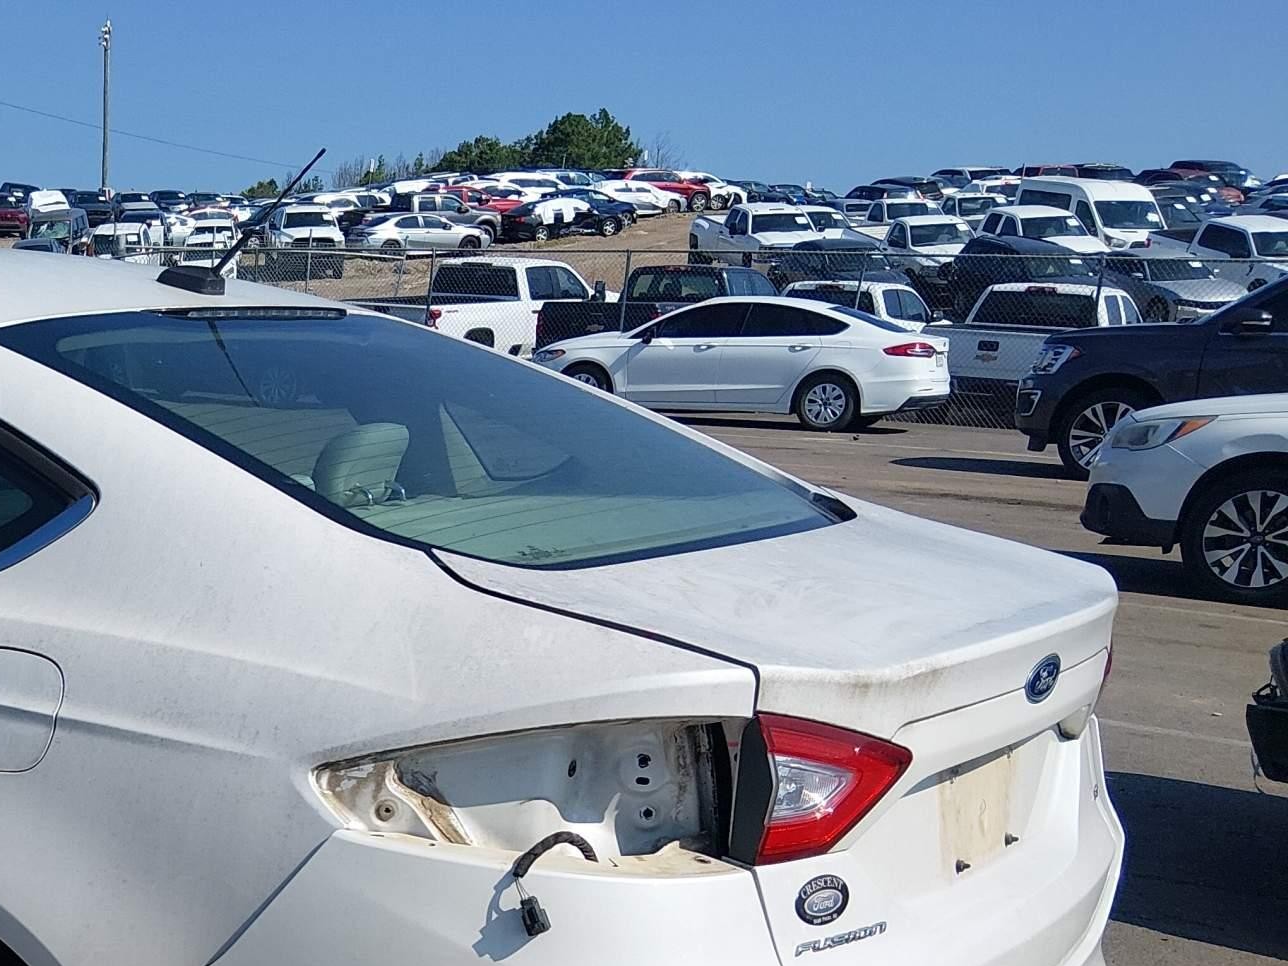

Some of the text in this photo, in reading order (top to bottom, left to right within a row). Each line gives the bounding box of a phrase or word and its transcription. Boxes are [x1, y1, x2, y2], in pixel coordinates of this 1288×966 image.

[800, 876, 844, 900] CRESCENT
[812, 894, 835, 912] Ford
[794, 921, 887, 958] FUSION
